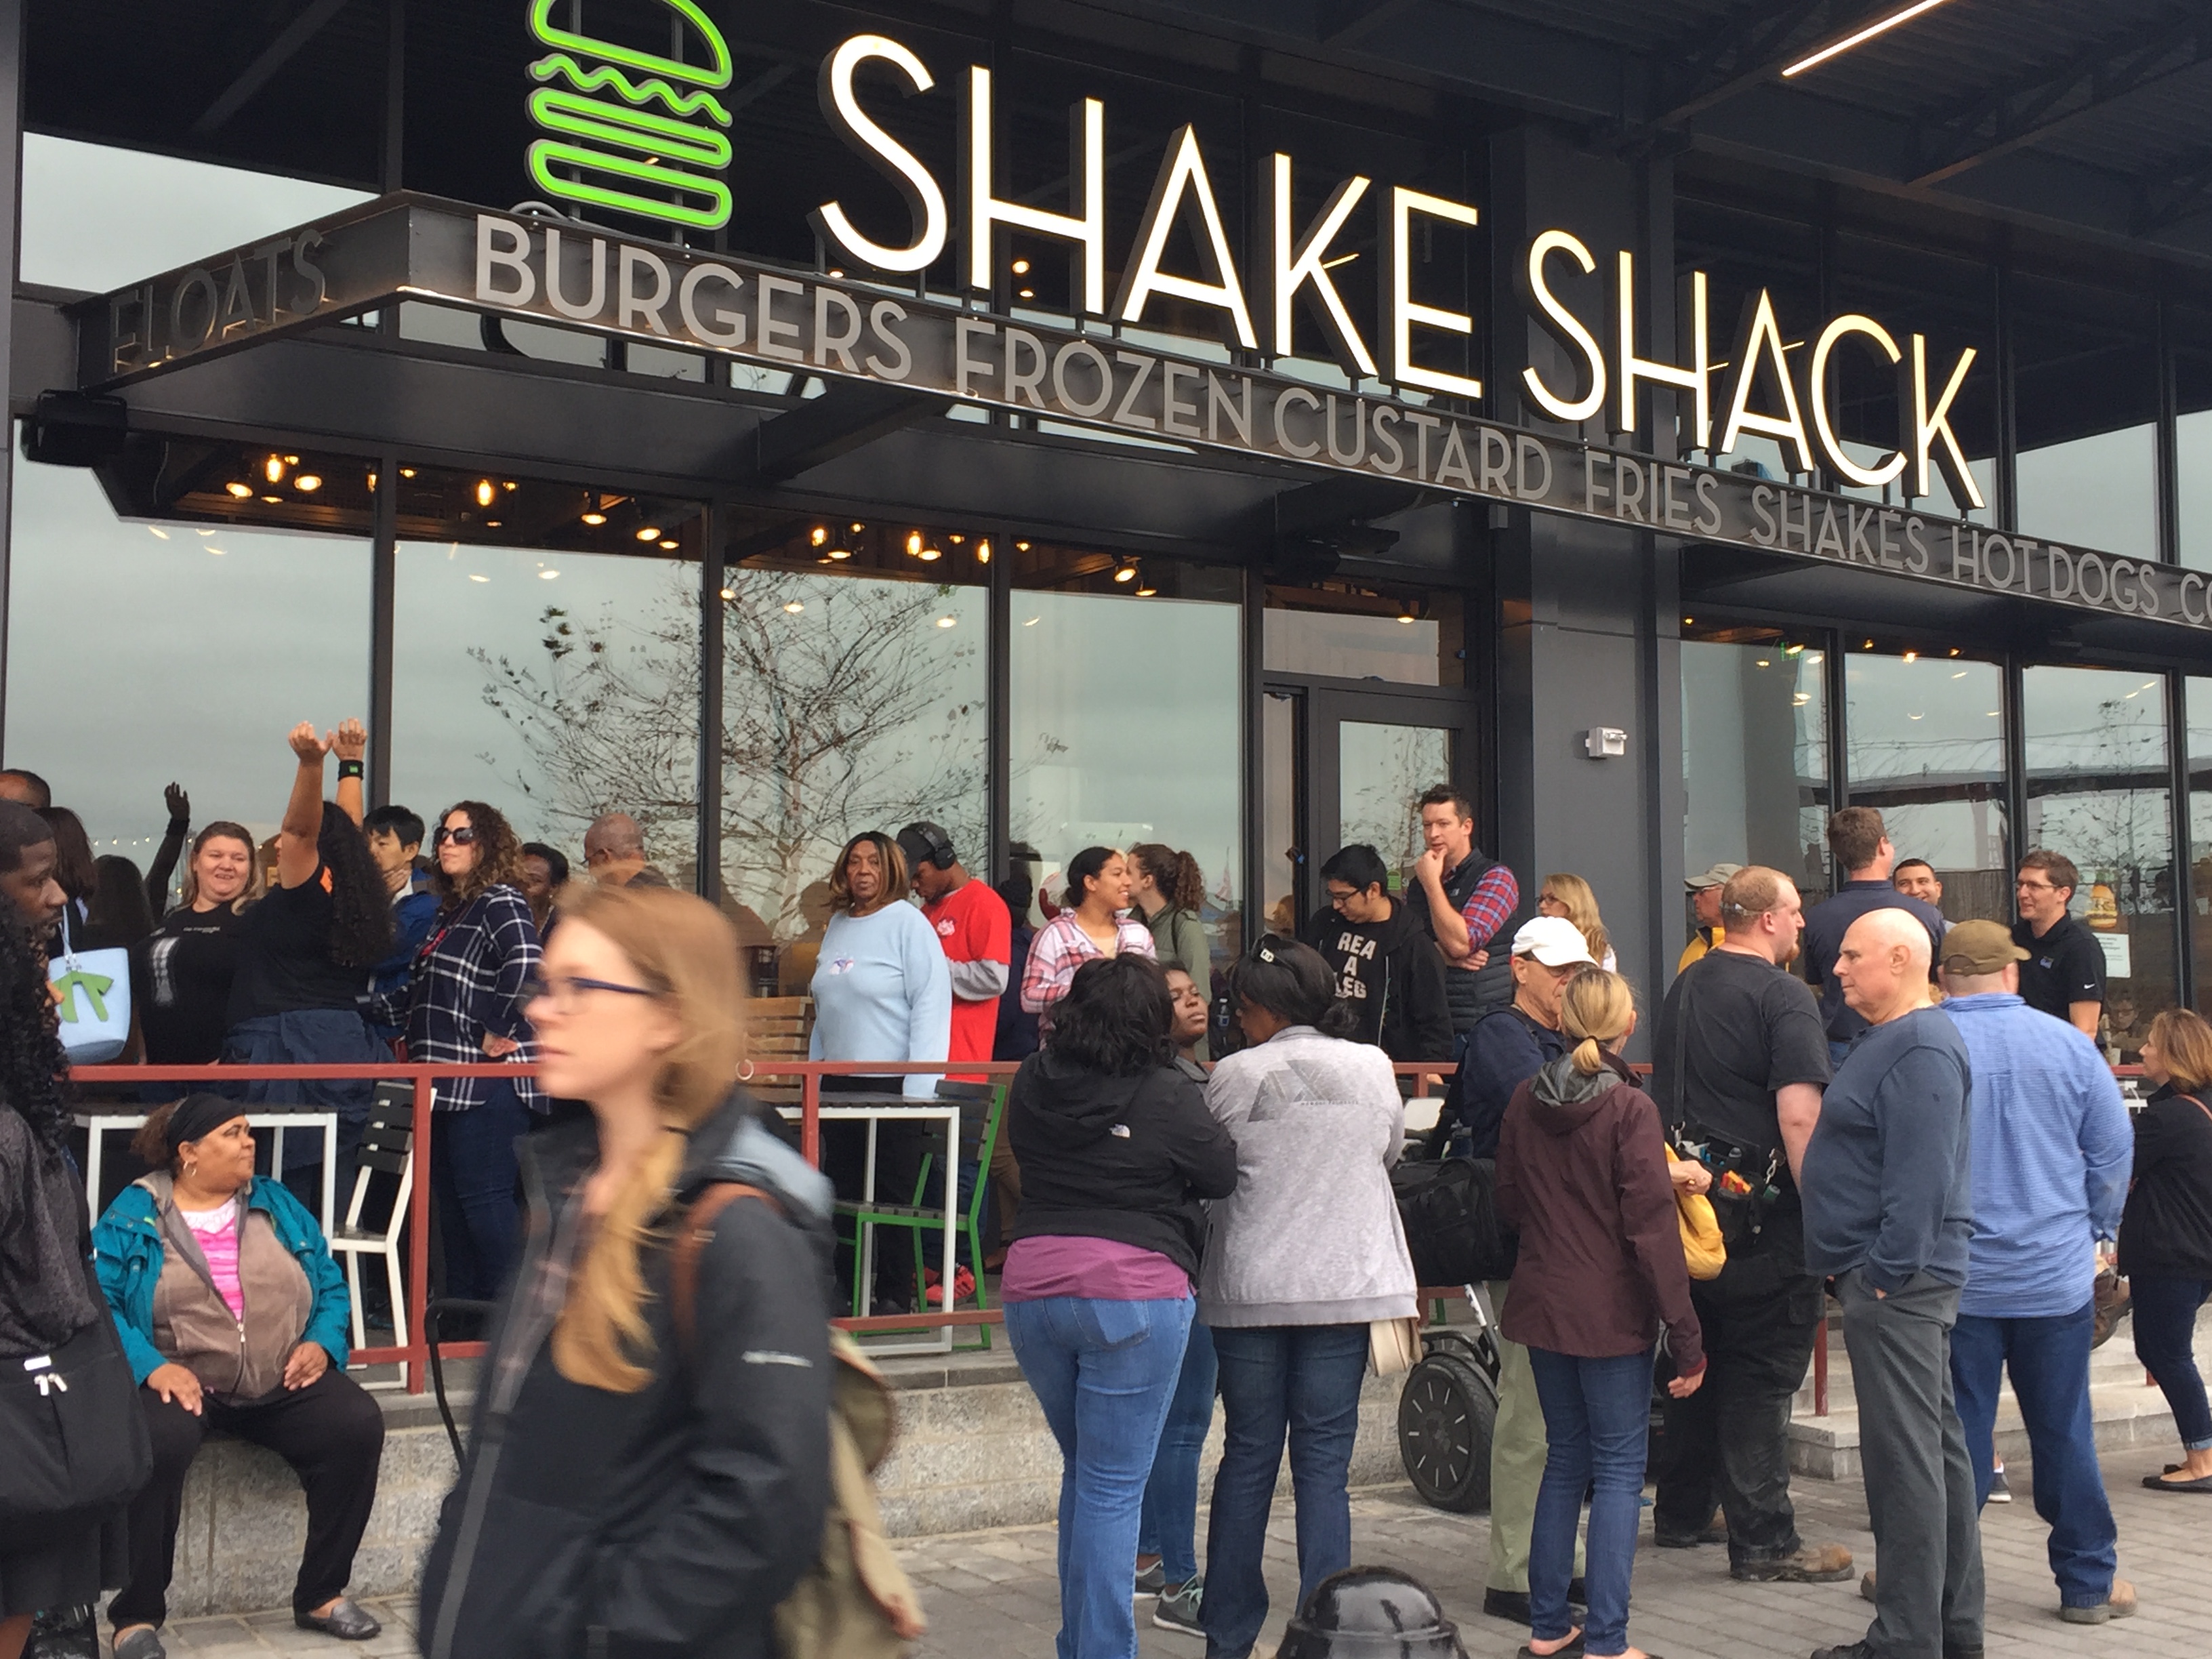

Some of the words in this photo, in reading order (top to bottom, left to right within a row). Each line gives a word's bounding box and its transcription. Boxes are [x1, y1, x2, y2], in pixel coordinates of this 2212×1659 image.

[108, 228, 324, 375] FLOATS
[817, 33, 1482, 399] SHAKE
[1520, 229, 1987, 509] SHACK
[476, 214, 912, 381] BURGERS
[955, 316, 1252, 447] FROZEN
[1273, 387, 1553, 500] CUSTARD
[1584, 450, 1722, 535] FRIES
[1750, 485, 1929, 574] SHAKES
[1952, 525, 2038, 594] HOT
[2049, 546, 2159, 615] DOGS
[2180, 573, 2212, 623] C
[1336, 931, 1376, 960] REA
[1343, 956, 1357, 977] A
